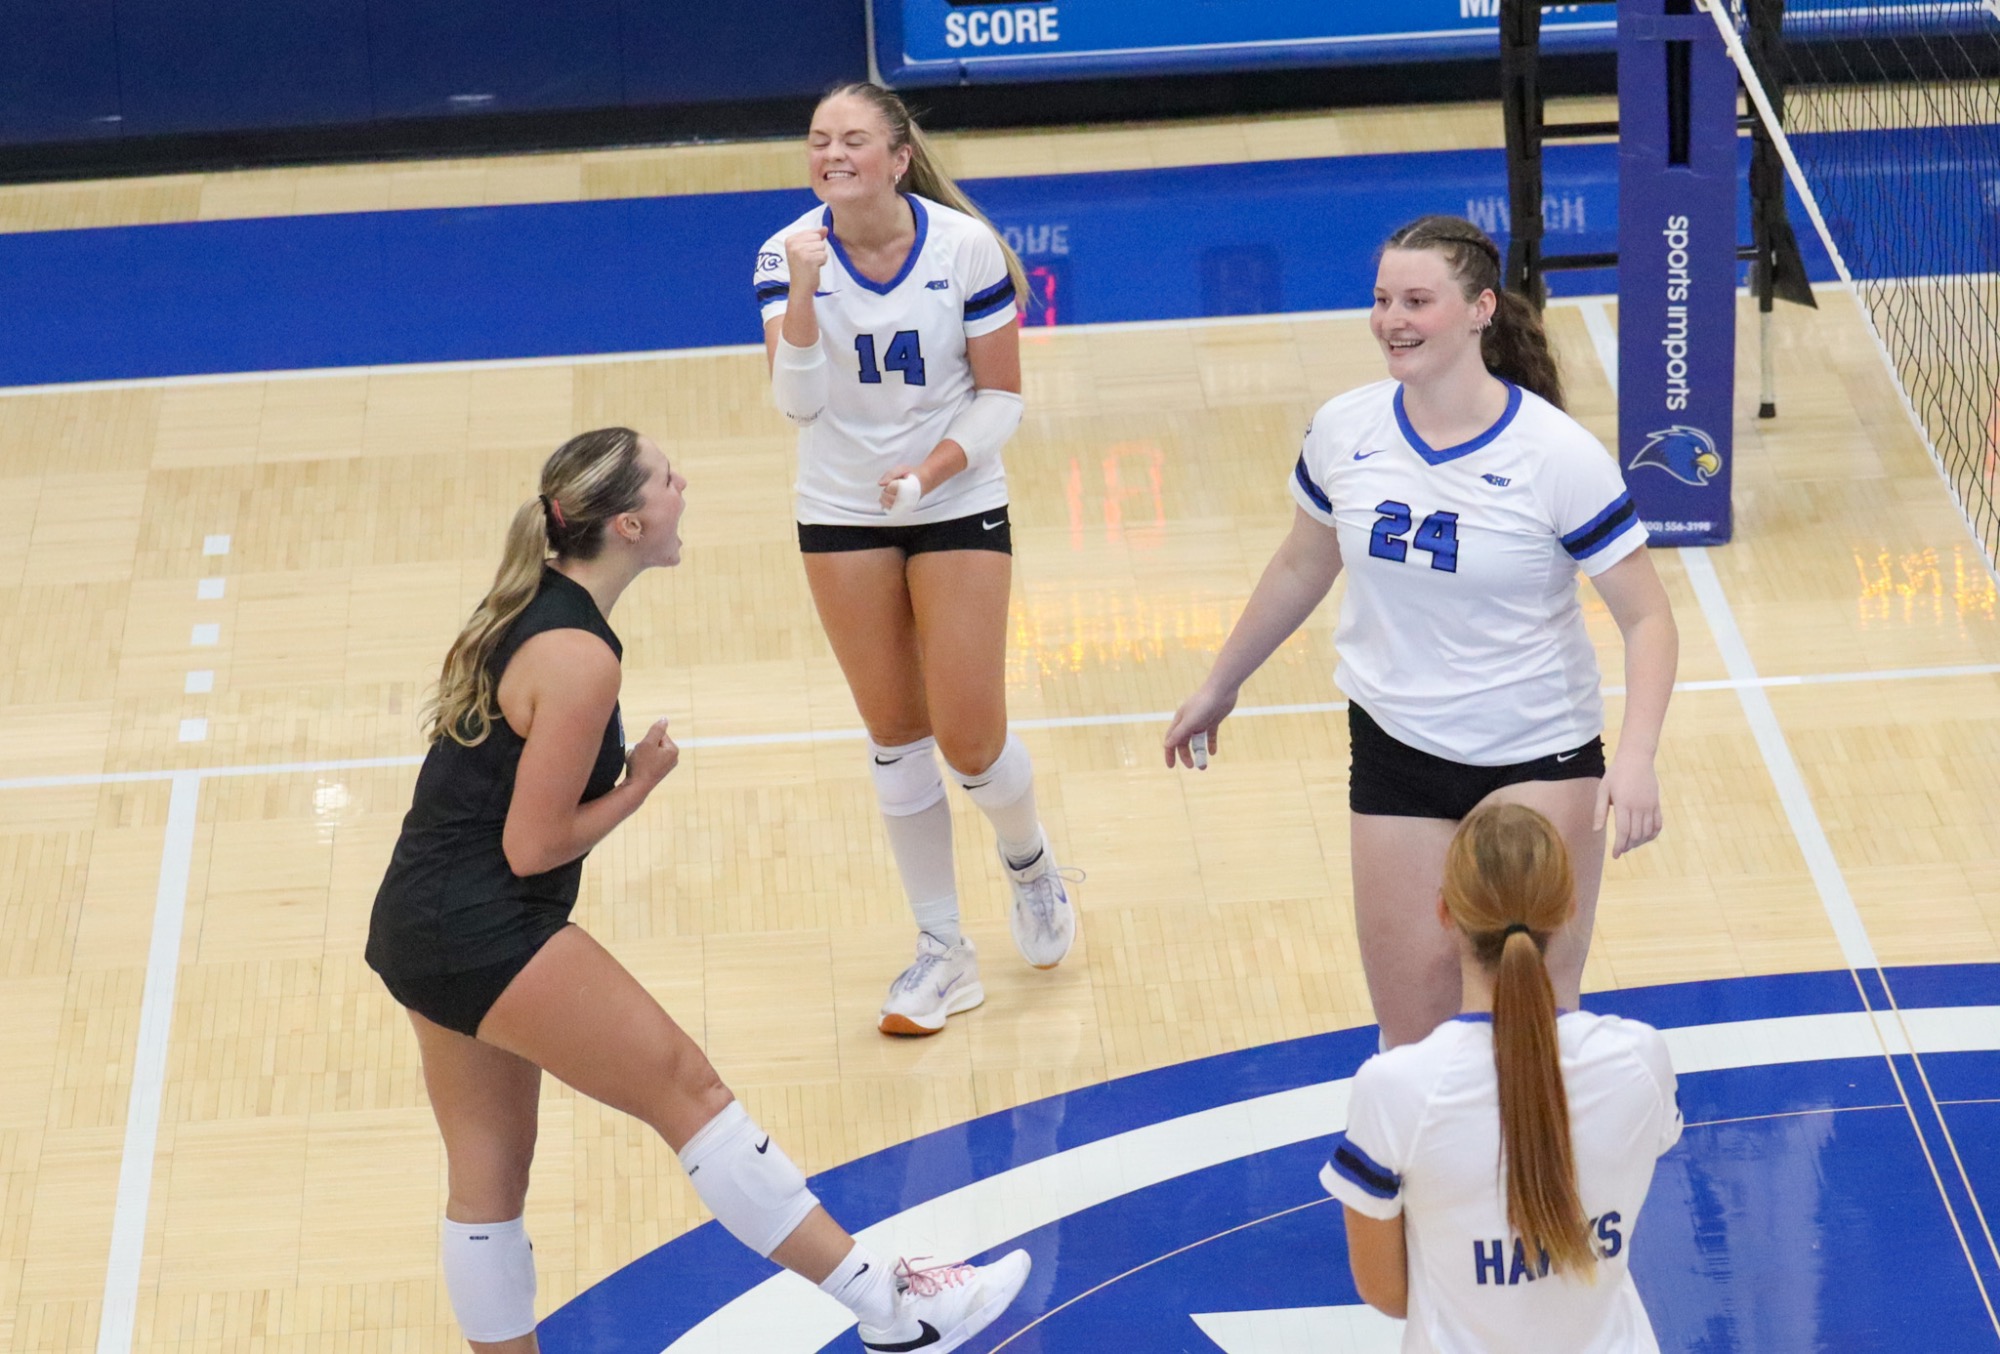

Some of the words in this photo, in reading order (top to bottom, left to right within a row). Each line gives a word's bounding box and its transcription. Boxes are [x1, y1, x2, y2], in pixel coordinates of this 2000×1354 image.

[945, 7, 1059, 48] SCORE
[1663, 215, 1692, 301] sports
[855, 330, 926, 386] 14
[1661, 306, 1691, 410] imports
[1369, 499, 1460, 574] 24
